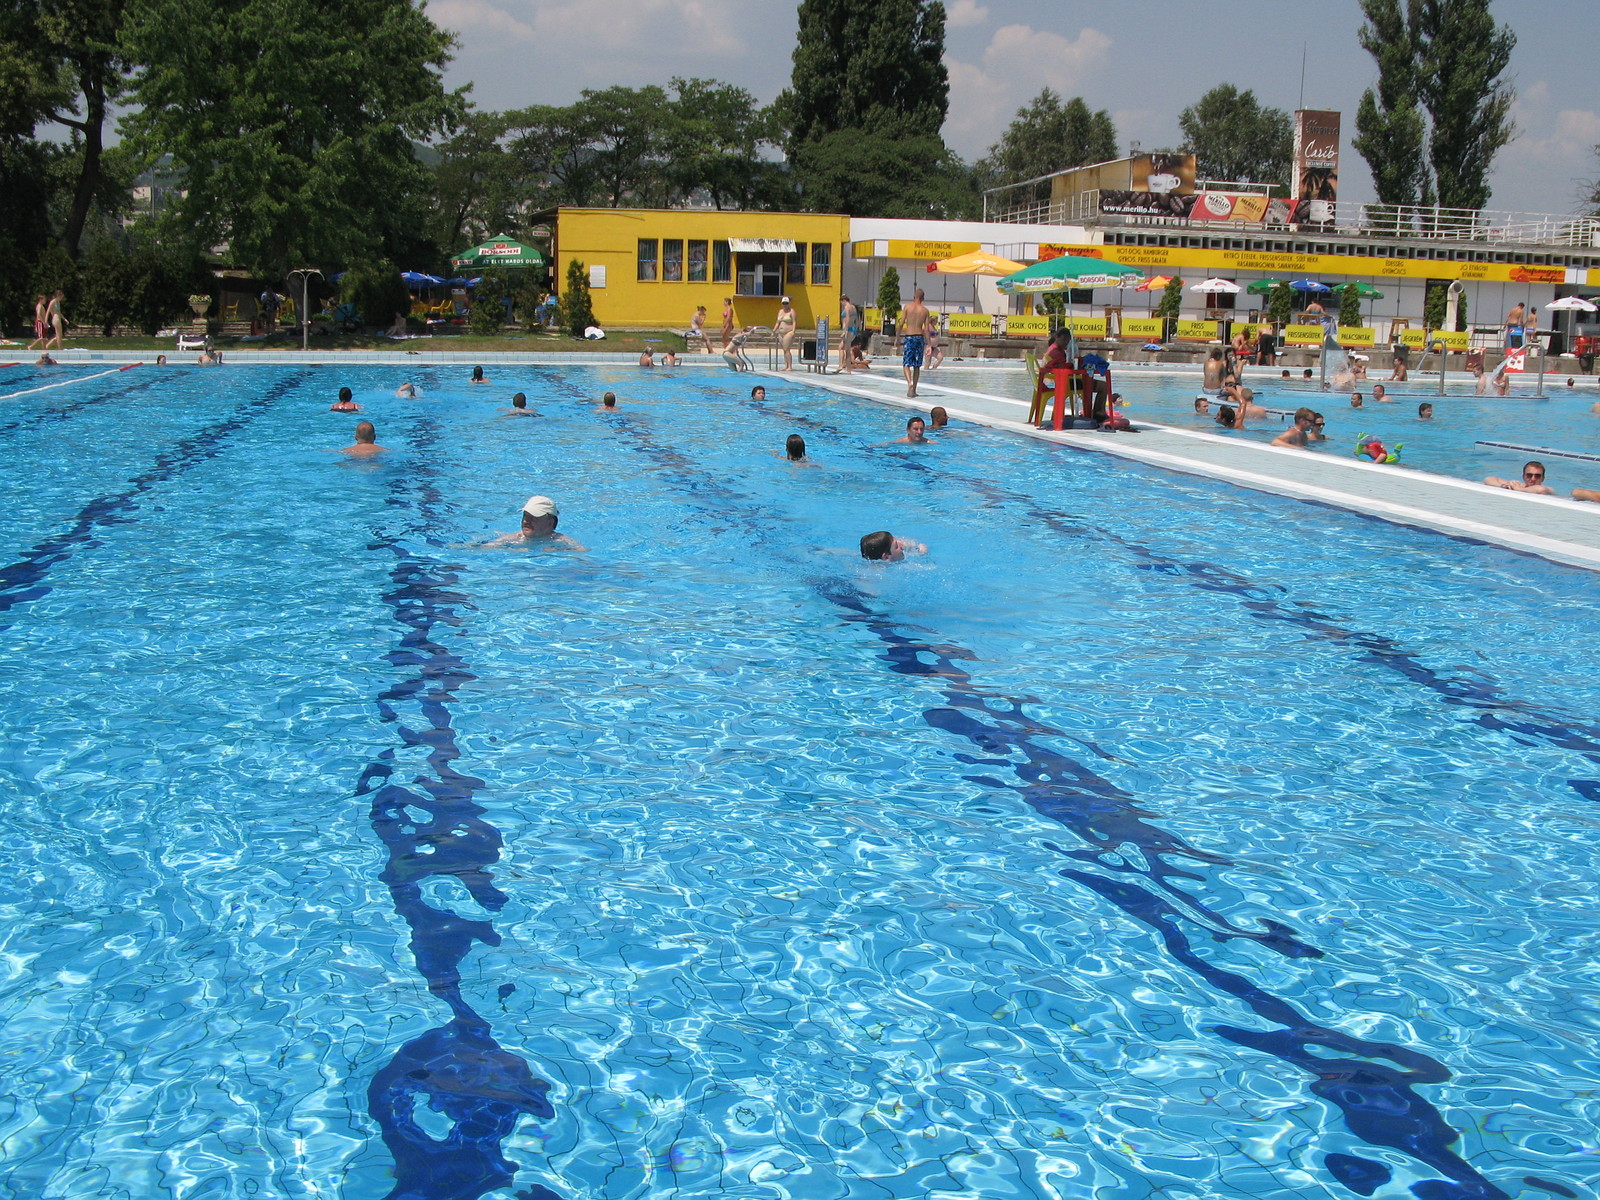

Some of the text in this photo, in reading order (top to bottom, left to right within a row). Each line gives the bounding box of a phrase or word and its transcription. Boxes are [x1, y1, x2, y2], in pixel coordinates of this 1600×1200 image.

[1103, 204, 1159, 214] www.merillo.hu
[1026, 278, 1052, 287] BORSODI
[1080, 276, 1106, 284] BORSODI
[1027, 322, 1047, 330] GYROS
[1128, 324, 1156, 332] FRISS HEKK
